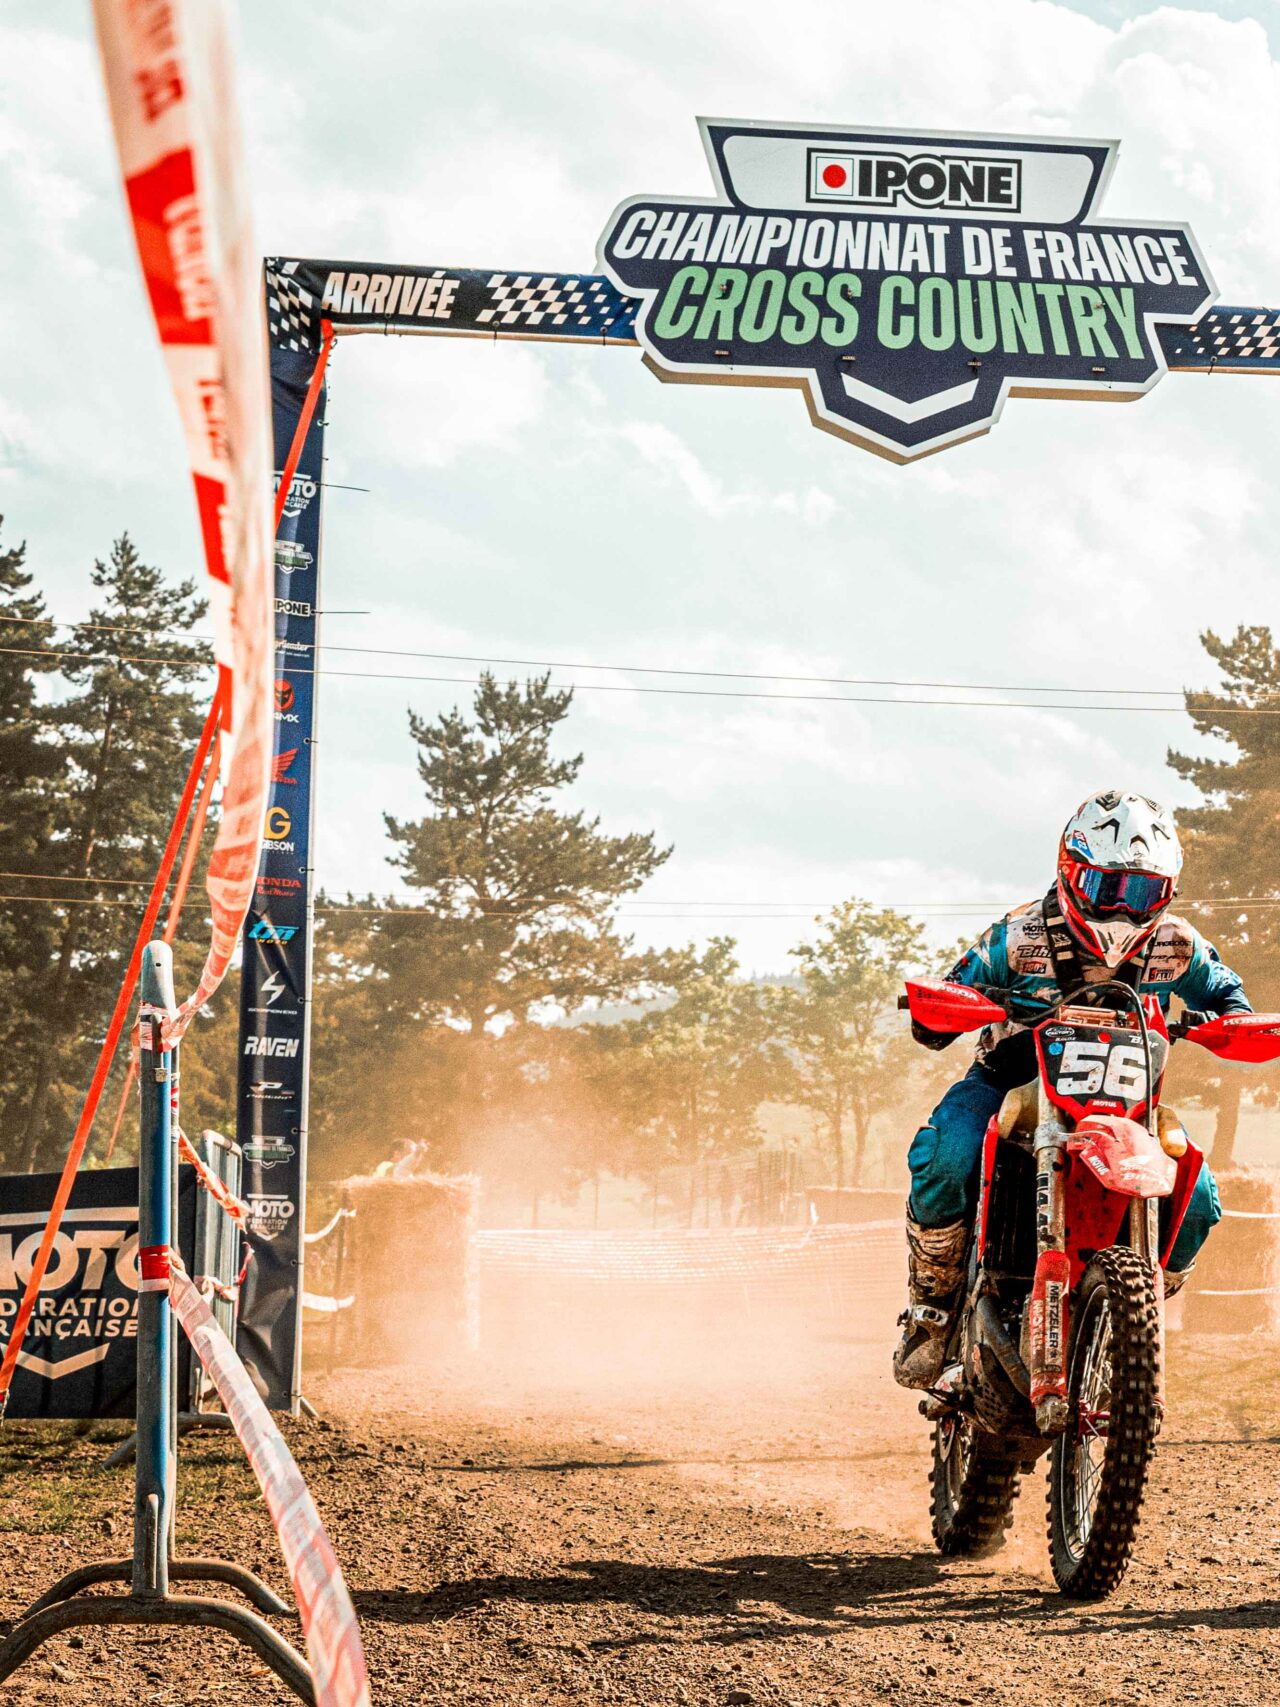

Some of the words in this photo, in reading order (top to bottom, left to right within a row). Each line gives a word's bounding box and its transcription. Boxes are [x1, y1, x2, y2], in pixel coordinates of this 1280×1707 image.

[858, 158, 1014, 205] IPONE
[613, 209, 949, 273] CHAMPIONNAT
[964, 227, 1016, 278] DE
[1028, 230, 1199, 287] FRANCE
[321, 271, 460, 320] ARRIVÉE
[653, 265, 863, 348] CROSS
[876, 275, 1146, 360] COUNTRY
[1017, 945, 1051, 958] Bih
[244, 1036, 300, 1057] RAVEN
[1056, 1041, 1147, 1101] 56
[1092, 1100, 1118, 1108] MOTUL
[1049, 1284, 1060, 1350] METZELER
